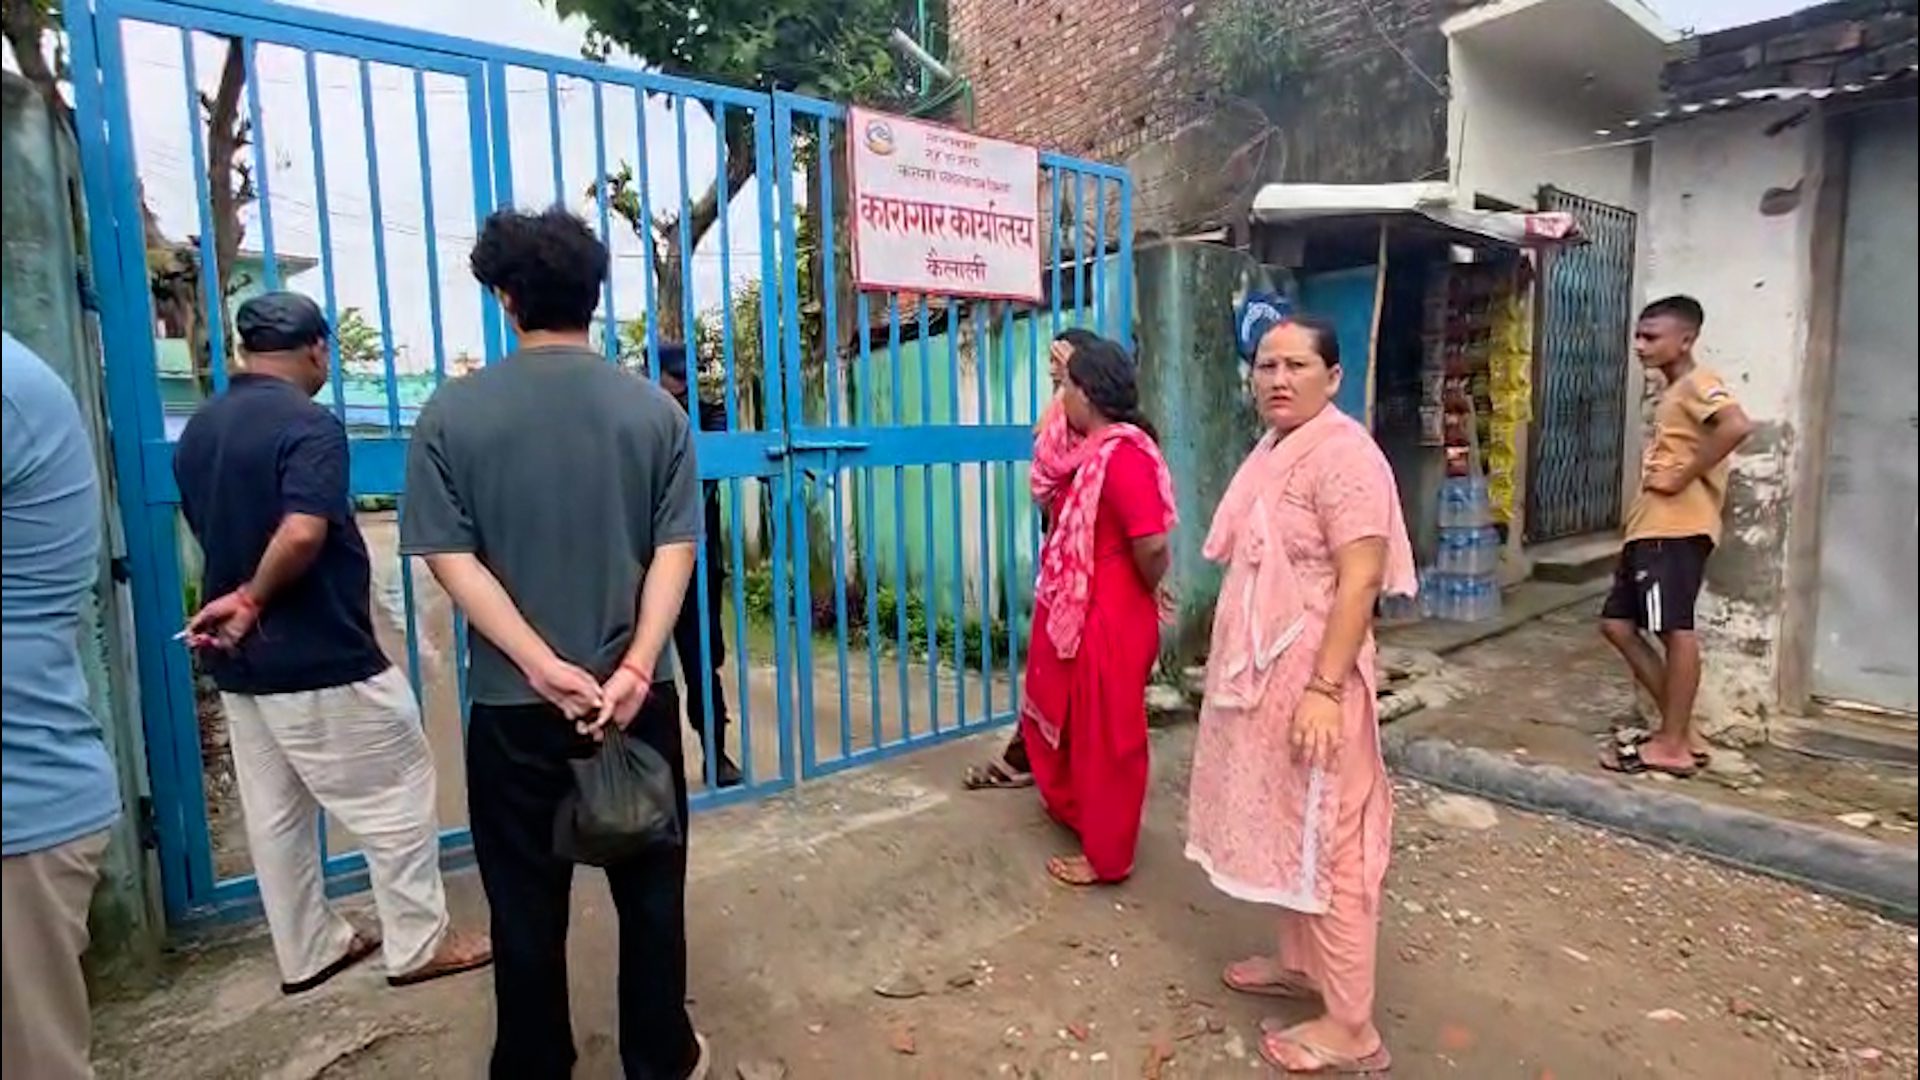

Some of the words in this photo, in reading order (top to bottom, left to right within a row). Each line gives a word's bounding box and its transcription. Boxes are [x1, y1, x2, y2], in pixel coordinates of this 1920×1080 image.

[861, 194, 946, 238] कारागार
[950, 200, 1034, 248] कार्यालय
[926, 247, 987, 280] कैलाली
